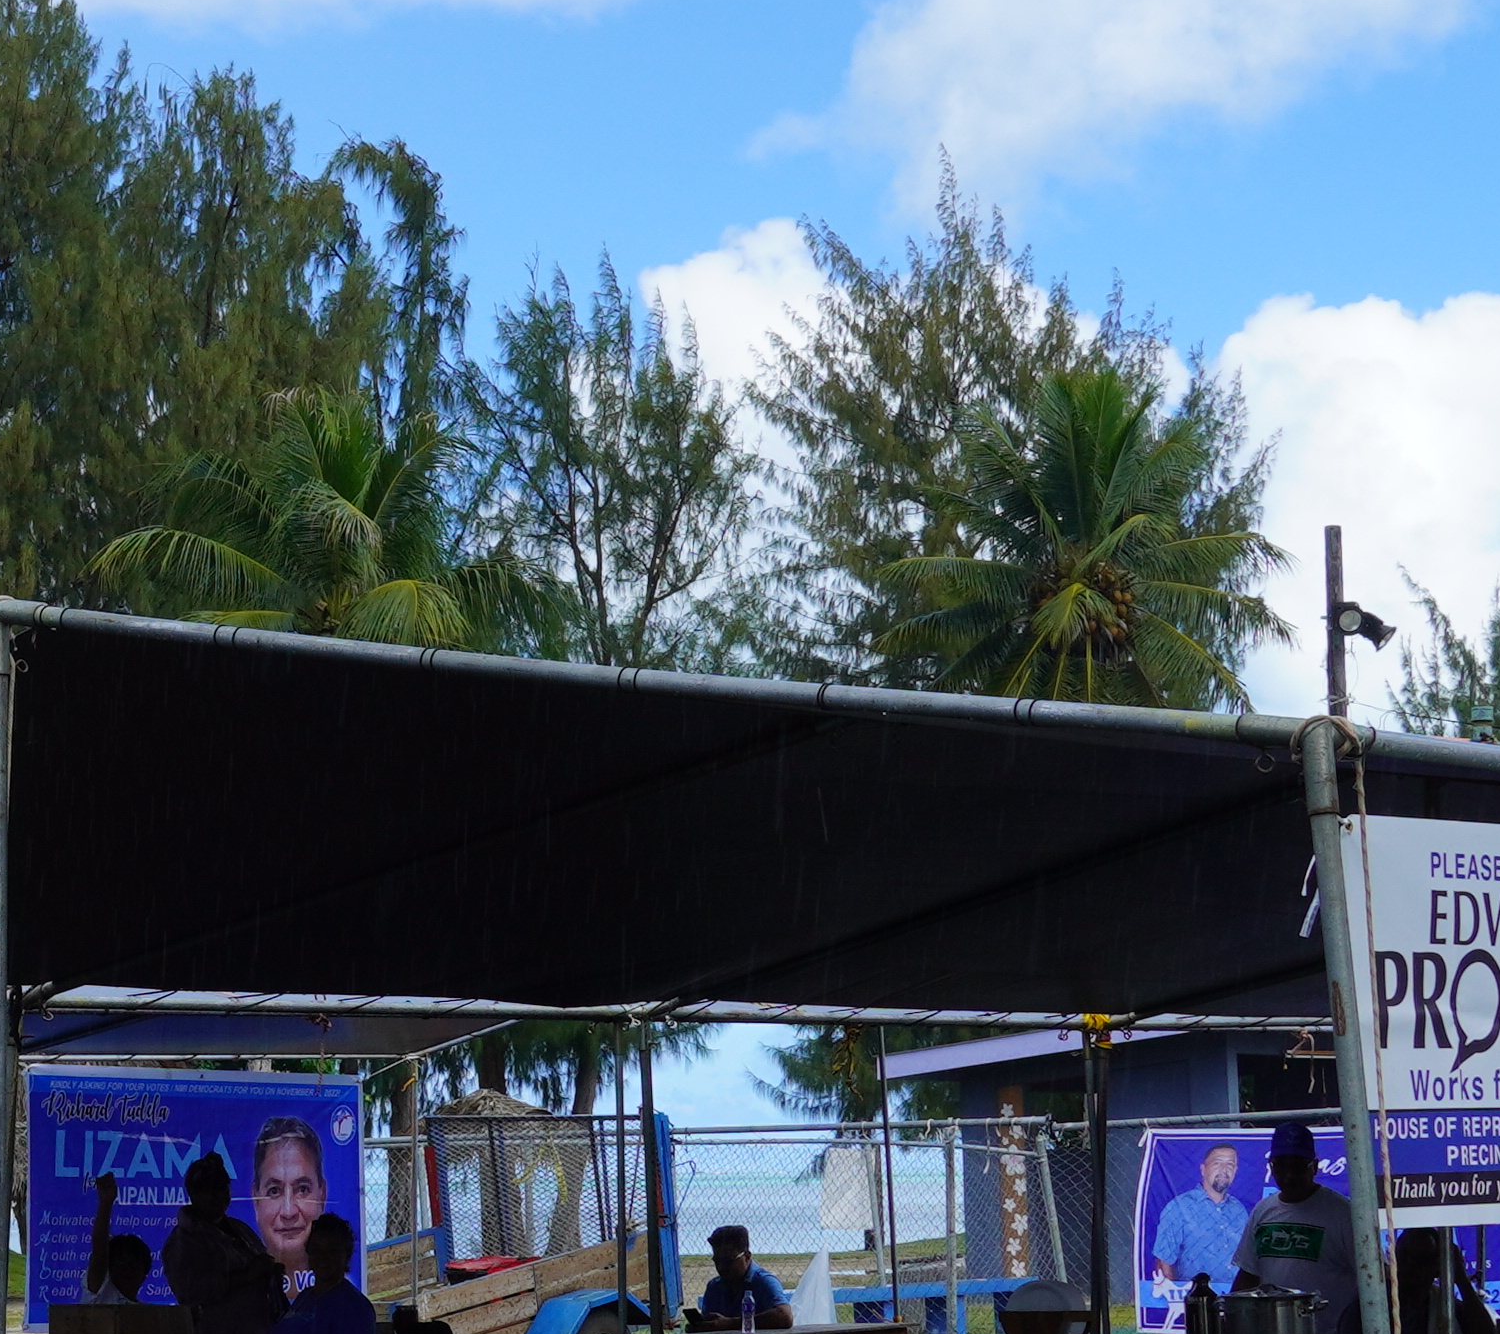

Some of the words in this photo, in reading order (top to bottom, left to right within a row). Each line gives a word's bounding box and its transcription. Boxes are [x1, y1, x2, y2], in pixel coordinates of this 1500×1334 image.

[50, 1080, 76, 1090] KINDLY
[78, 1081, 106, 1091] ASKING
[107, 1082, 124, 1091] FOR
[125, 1082, 146, 1092] YOUR
[146, 1083, 169, 1093] VOTES
[188, 1085, 232, 1095] DEMOCRATS
[234, 1086, 248, 1095] FOR
[249, 1086, 265, 1096] YOU
[266, 1087, 276, 1096] ON
[277, 1087, 314, 1097] NOVEMBER
[1410, 1068, 1484, 1102] Works
[41, 1089, 114, 1125] Richard
[1374, 1115, 1429, 1141] HOUSE
[1434, 1115, 1457, 1139] OF
[54, 1128, 238, 1180] LIZAMA
[1392, 1176, 1436, 1200] Thank
[1439, 1179, 1470, 1204] you
[1470, 1172, 1493, 1199] for
[115, 1215, 140, 1228] help
[142, 1217, 161, 1227] our
